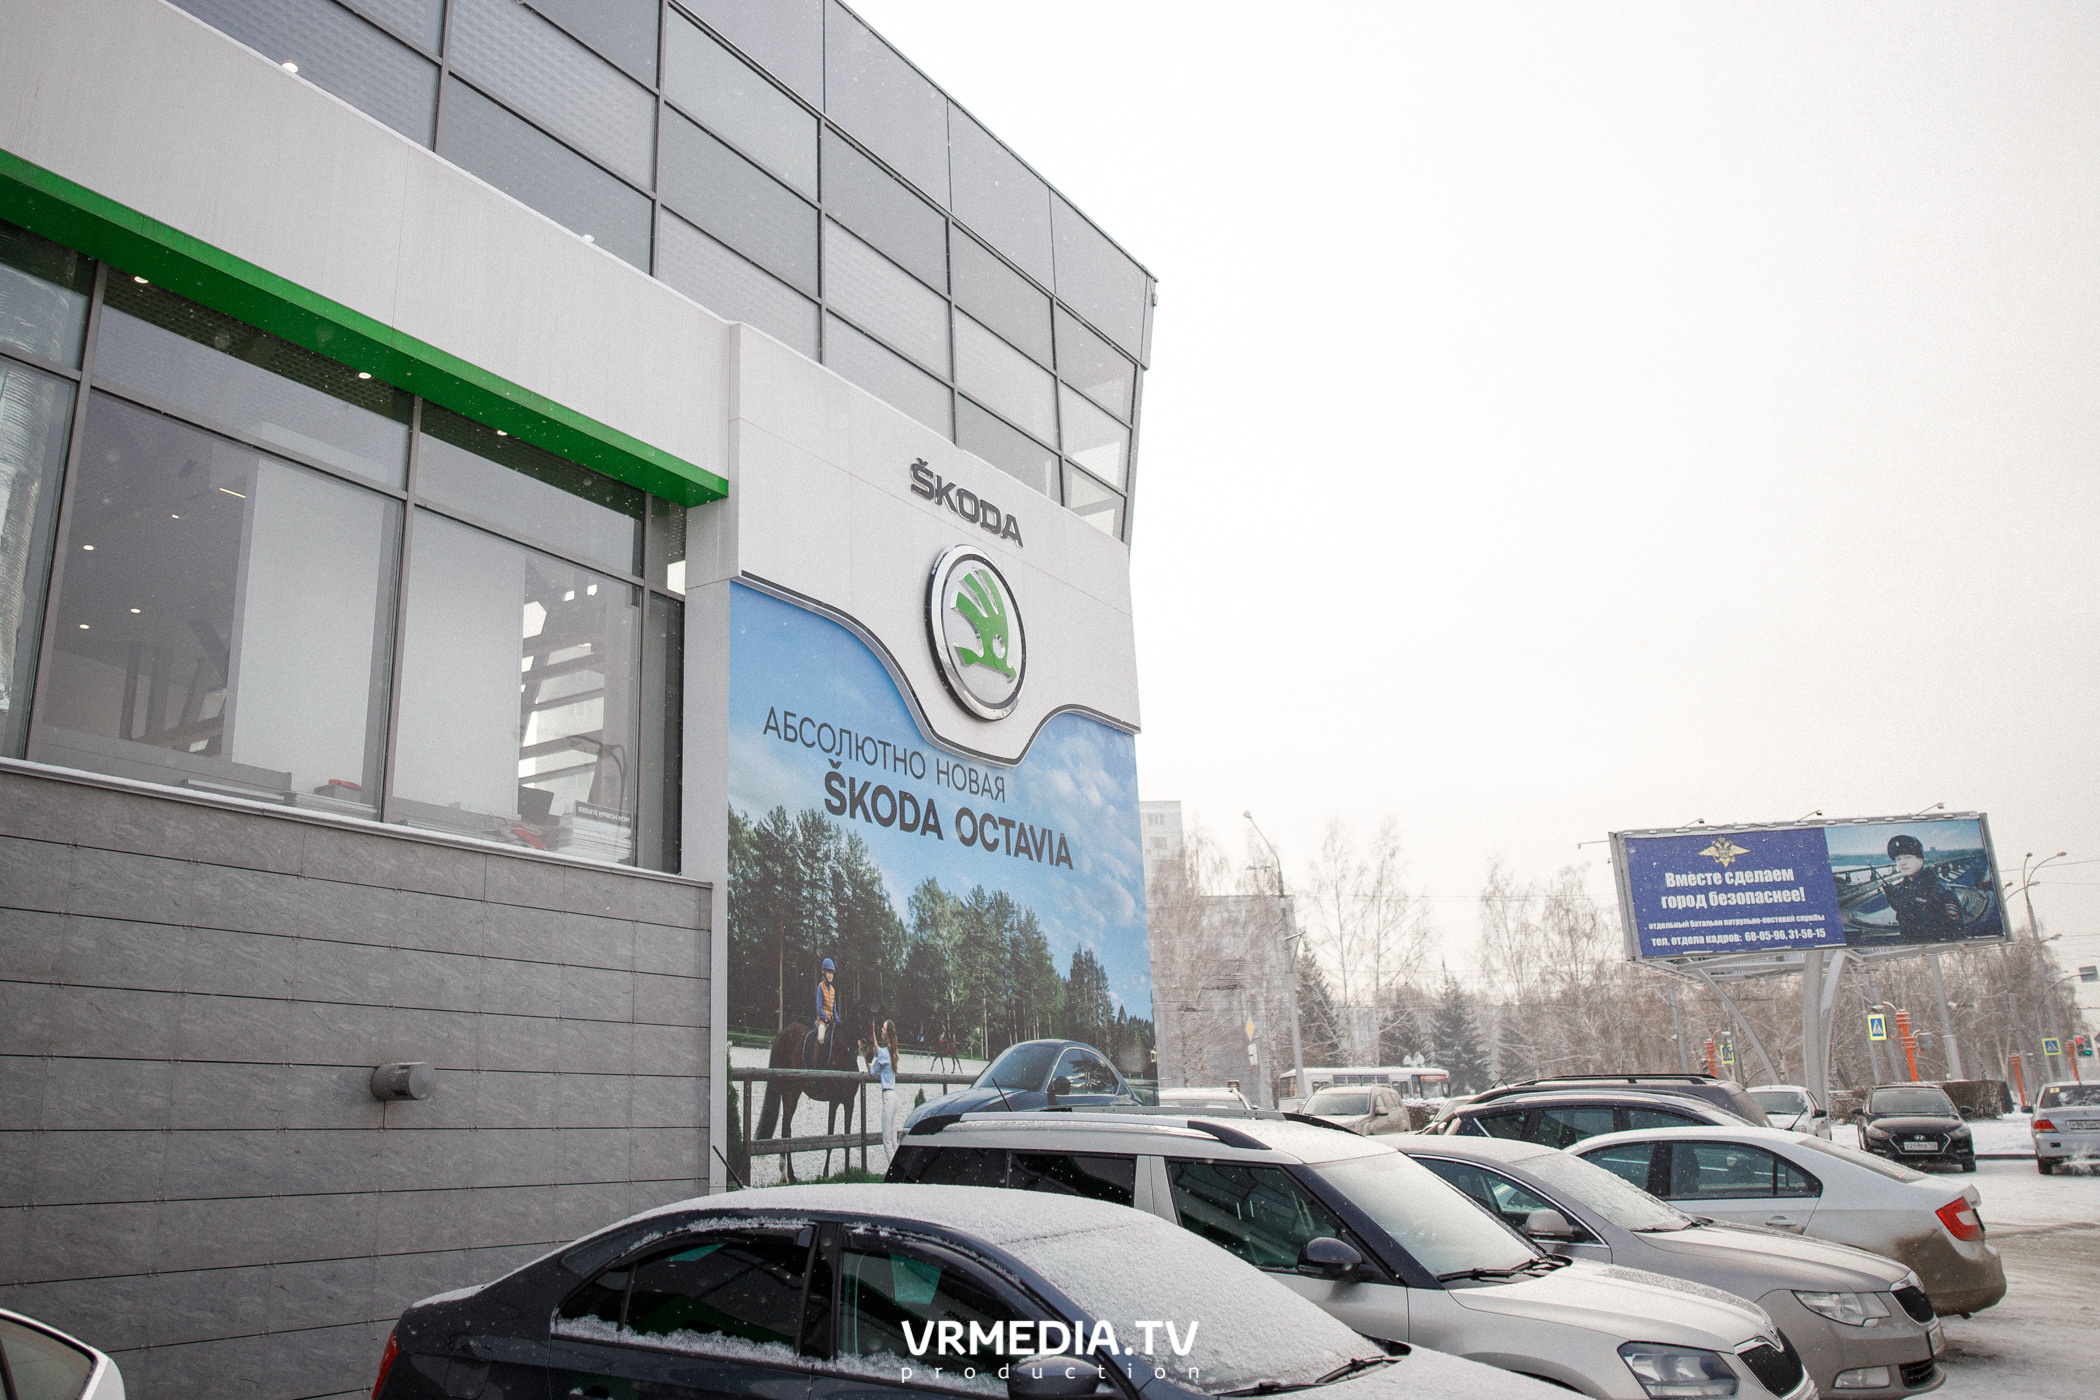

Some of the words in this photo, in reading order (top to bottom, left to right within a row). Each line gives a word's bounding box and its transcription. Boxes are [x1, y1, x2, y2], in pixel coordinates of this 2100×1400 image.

[910, 458, 1024, 547] ŠKODA
[763, 706, 925, 779] АБСОЛЮТНО
[937, 759, 1005, 802] НОВАЯ
[824, 759, 943, 840] ŠKODA
[955, 809, 1073, 870] OCTAVIA
[1665, 871, 1722, 888] Вместе
[1725, 868, 1794, 886] сделаем
[1661, 893, 1707, 910] город
[1709, 887, 1805, 906] безопаснее!
[1648, 922, 1689, 930] отдельный
[1690, 919, 1723, 929] батальон
[1797, 913, 1825, 923] службы
[1652, 937, 1670, 946] тел.
[1671, 935, 1703, 945] отдела
[1706, 934, 1742, 944] кадров:
[1744, 930, 1787, 942] 68-05-96,
[1789, 928, 1826, 940] 31-58-15
